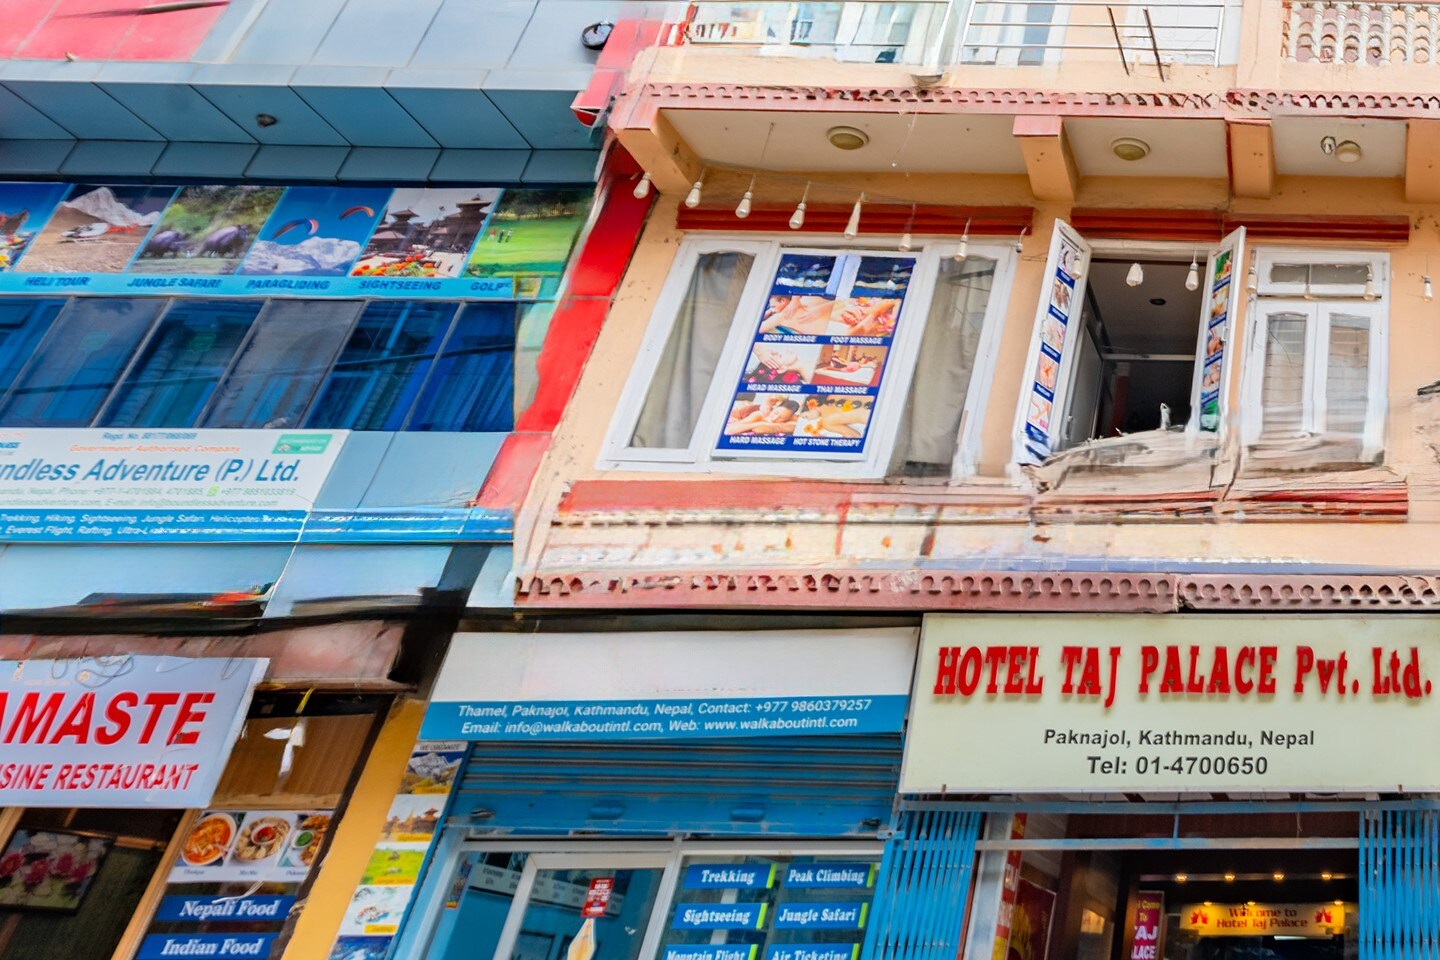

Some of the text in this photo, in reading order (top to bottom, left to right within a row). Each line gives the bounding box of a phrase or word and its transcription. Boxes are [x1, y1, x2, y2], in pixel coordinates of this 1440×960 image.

[126, 278, 223, 289] JUNGLE SAFARI
[244, 279, 331, 290] PARAGLIDING
[358, 280, 442, 290] SIGHTSEEING
[783, 334, 817, 343] MASSAGE
[767, 384, 802, 393] MASSAGE
[834, 386, 869, 394] MASSAGE
[750, 436, 786, 445] MASSAGE
[830, 439, 862, 447] THERAPY
[81, 458, 211, 481] Adventure
[214, 458, 254, 482] (P.)
[255, 459, 301, 482] Ltd.
[932, 645, 1433, 709] HOTEL TAJ PALACE Pvt. Ltd.
[458, 704, 508, 719] Thamel,
[573, 704, 650, 717] Kathmandu,
[654, 703, 694, 718] Nepal,
[697, 702, 752, 715] Contact:
[755, 701, 788, 714] +977
[790, 699, 873, 712] 9860379257
[0, 691, 216, 745] MASTE
[460, 717, 858, 736] Email: info@walkaboutintl.com, Web: www.walkaboutintl.com
[1043, 729, 1316, 750] Paknajol, Kathmandu, Nepal
[1086, 756, 1269, 775] Tel: 01-4700650
[52, 763, 200, 791] RESTAURANT
[701, 869, 757, 886] Trekking
[788, 868, 867, 885] Peak Climbing
[179, 899, 282, 920] Nepali Food
[683, 909, 752, 925] Sightseeing
[779, 908, 857, 925] Jungle Safari
[1228, 907, 1298, 918] Welcome to
[1216, 918, 1248, 928] Hotel
[1269, 918, 1309, 928] Palace
[1134, 925, 1158, 940] AJ
[161, 937, 266, 956] Indian Food
[1131, 944, 1157, 959] LACE
